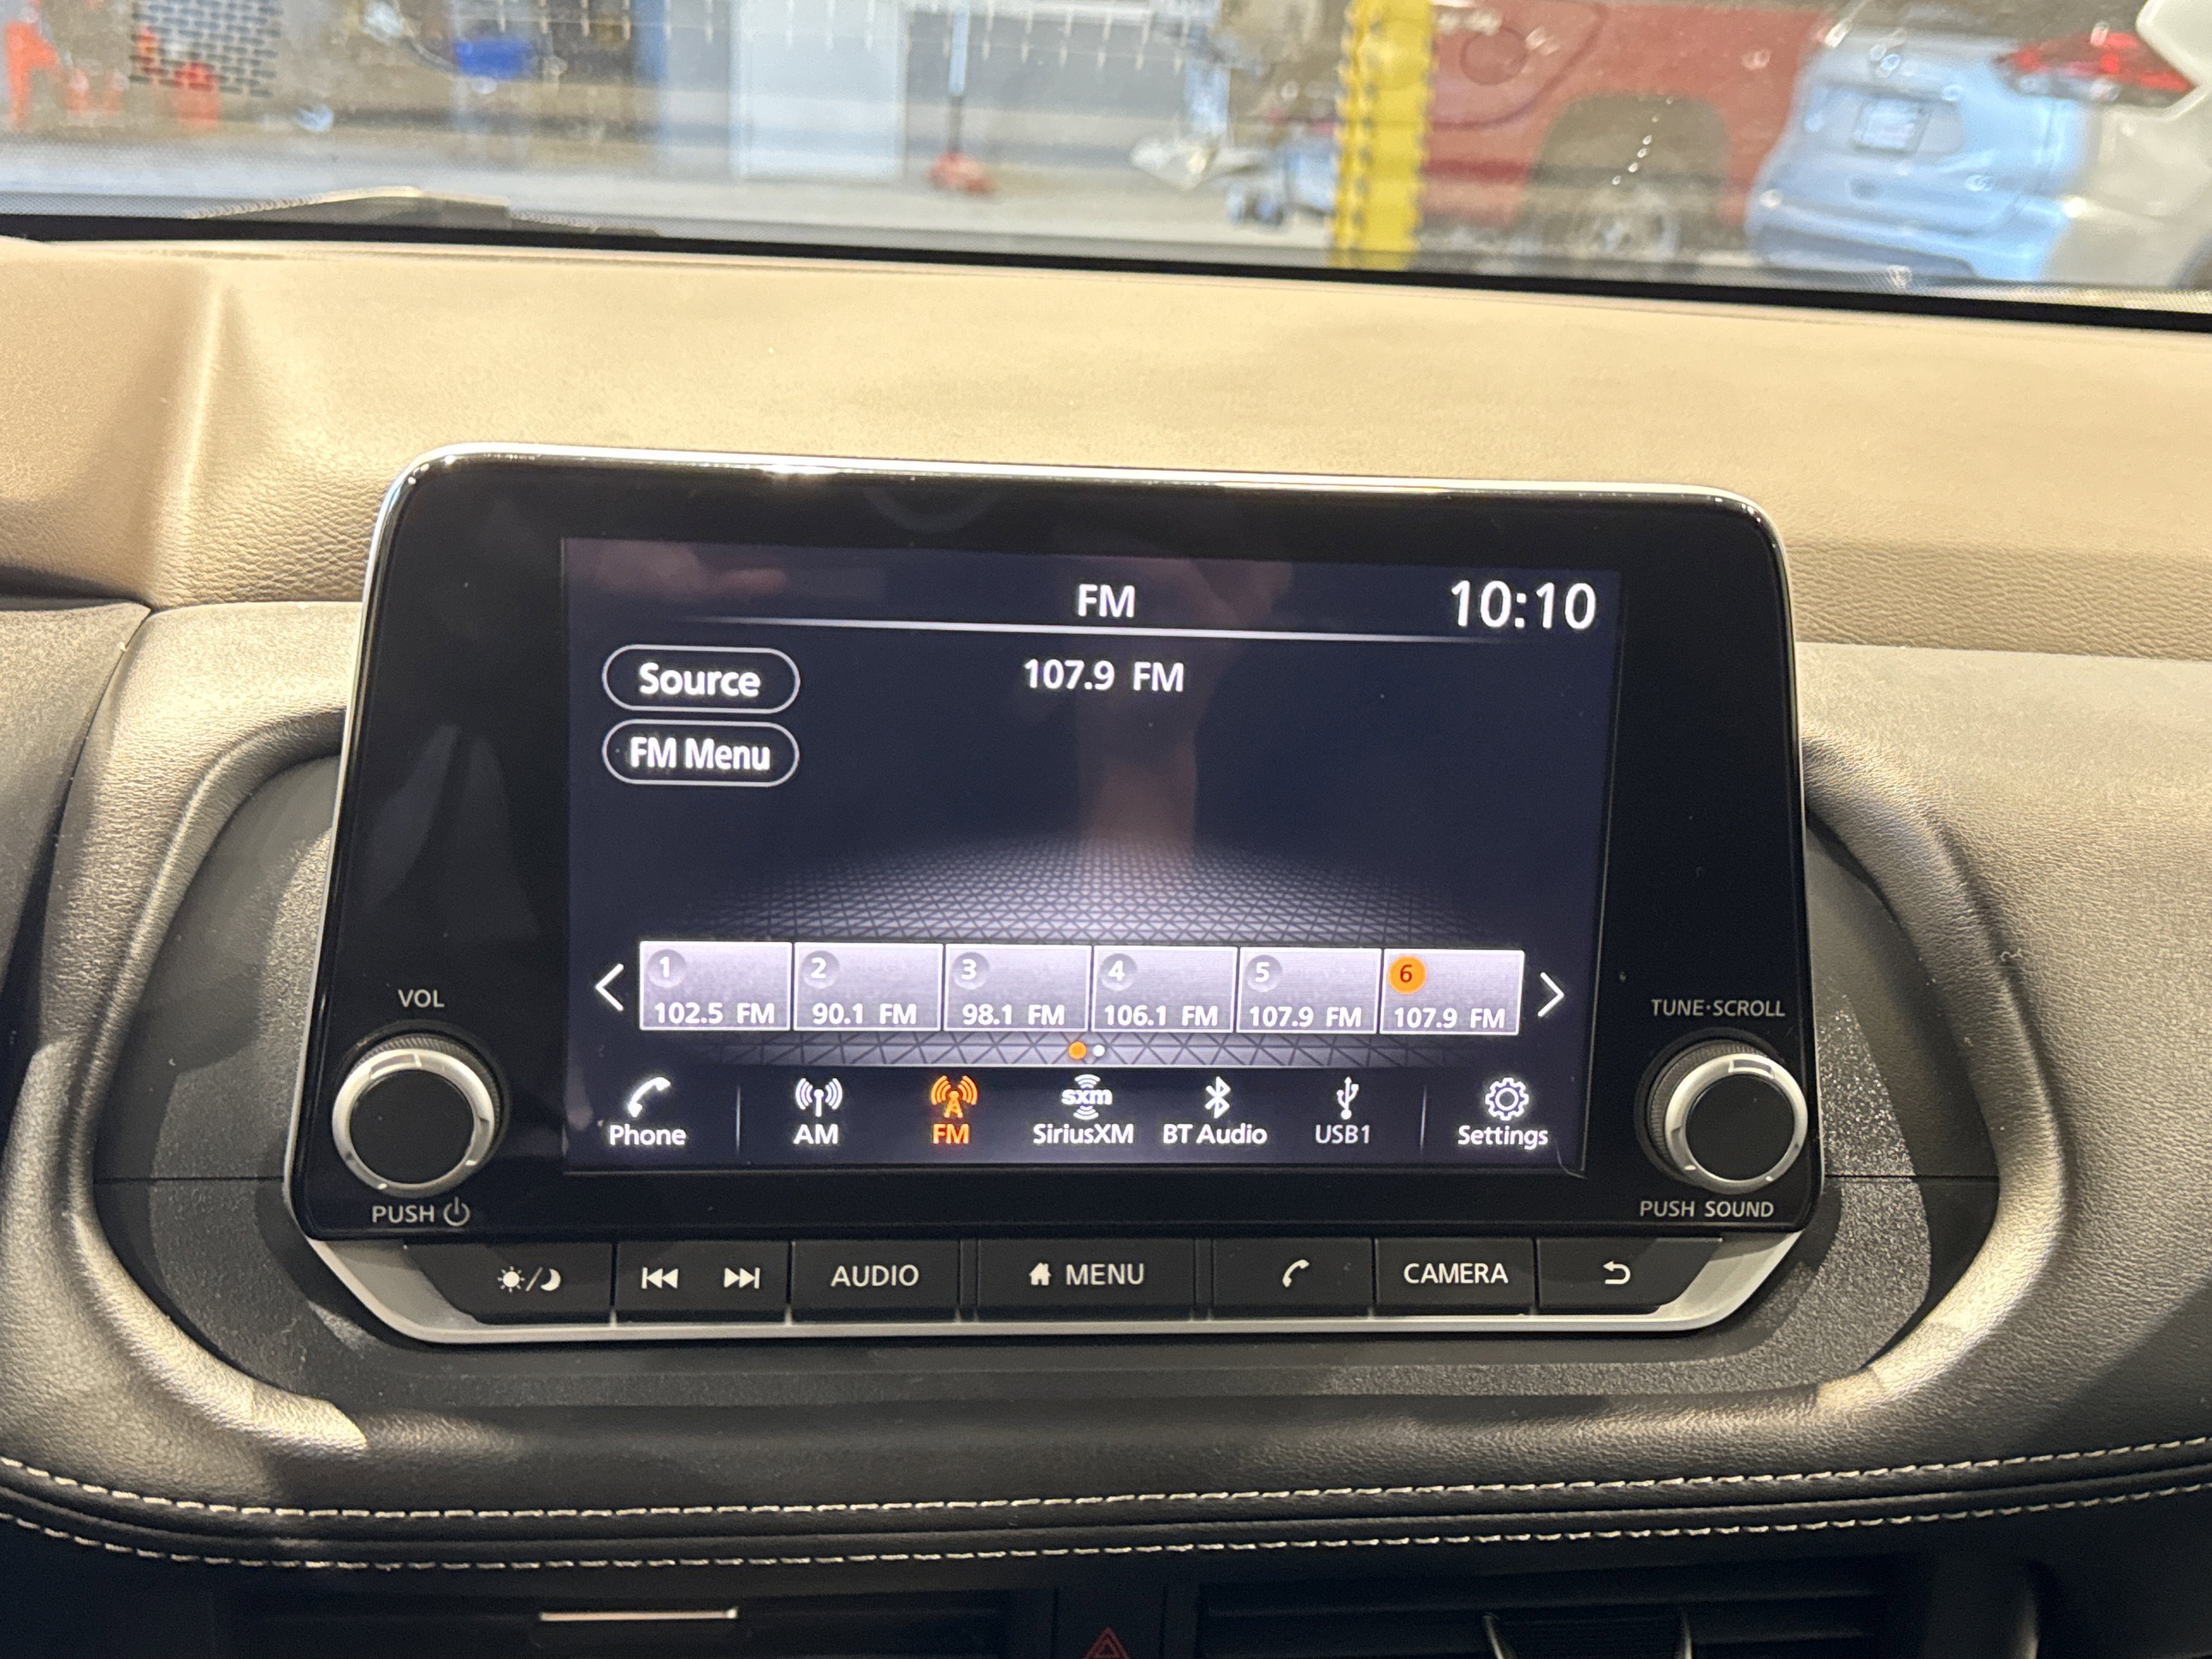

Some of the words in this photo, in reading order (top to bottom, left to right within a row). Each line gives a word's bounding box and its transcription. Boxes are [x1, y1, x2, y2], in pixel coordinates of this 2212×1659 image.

[1077, 584, 1135, 618] FM
[1451, 580, 1596, 629] 10:10
[639, 662, 761, 697] Source
[1024, 658, 1115, 691] 107.9
[1133, 661, 1184, 692] FM
[630, 736, 677, 769] FM
[684, 737, 770, 771] Menu
[659, 957, 671, 978] 1
[811, 958, 827, 979] 2
[961, 959, 977, 980] 3
[1108, 960, 1125, 981] 4
[1255, 962, 1269, 983] 5
[1400, 964, 1413, 983] 6
[398, 989, 444, 1008] VOL
[654, 1002, 723, 1024] 102.5
[737, 1002, 775, 1024] FM
[812, 1002, 863, 1025] 90.1
[879, 1003, 917, 1025] FM
[962, 1003, 1012, 1025] 98.1
[1028, 1004, 1065, 1025] FM
[1104, 1005, 1166, 1026] 106.1
[1182, 1005, 1218, 1026] FM
[1249, 1006, 1314, 1028] 107.9
[1325, 1006, 1362, 1027] FM
[1394, 1008, 1458, 1029] 107.9
[1470, 1008, 1505, 1029] FM
[1062, 1088, 1112, 1107] sxm
[608, 1123, 686, 1146] Phone
[793, 1124, 838, 1144] AM
[933, 1123, 969, 1144] FM
[1033, 1123, 1134, 1144] SiriusXM
[1163, 1124, 1193, 1144] BT
[1195, 1122, 1268, 1144] Audio
[1315, 1124, 1369, 1144] USB1
[1458, 1125, 1548, 1150] Settings
[373, 1205, 435, 1223] PUSH
[1640, 1200, 1695, 1217] PUSH
[1705, 1200, 1774, 1217] SOUND
[831, 1264, 919, 1287] AUDIO
[1066, 1263, 1144, 1285] MENU
[1404, 1263, 1509, 1284] CAMERA
